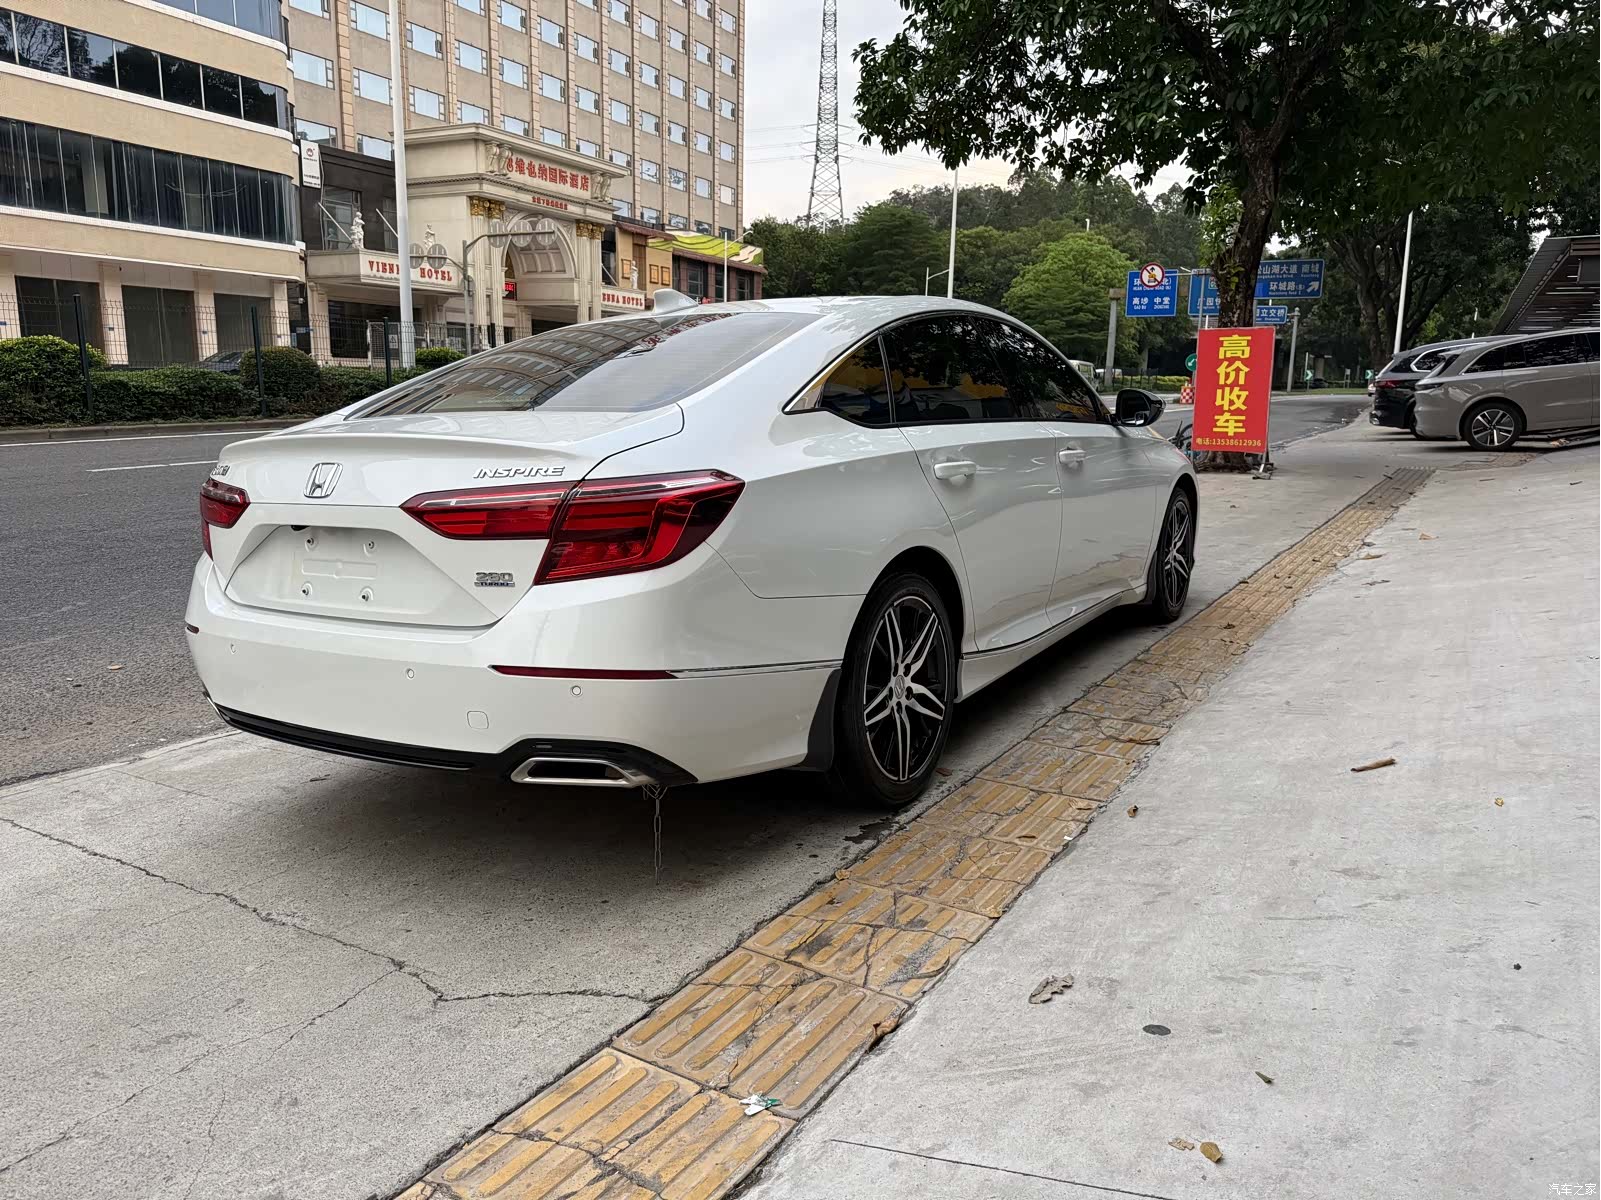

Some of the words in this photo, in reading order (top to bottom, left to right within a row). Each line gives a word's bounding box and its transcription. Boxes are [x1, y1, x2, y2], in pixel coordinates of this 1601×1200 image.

[514, 157, 589, 191] 维也纳国际酒店
[419, 267, 452, 282] HOTEL
[622, 296, 643, 306] HOTEL
[1213, 334, 1252, 436] 高价收车
[1195, 437, 1262, 447] 电话:13538612936
[473, 465, 566, 479] INSPIRE
